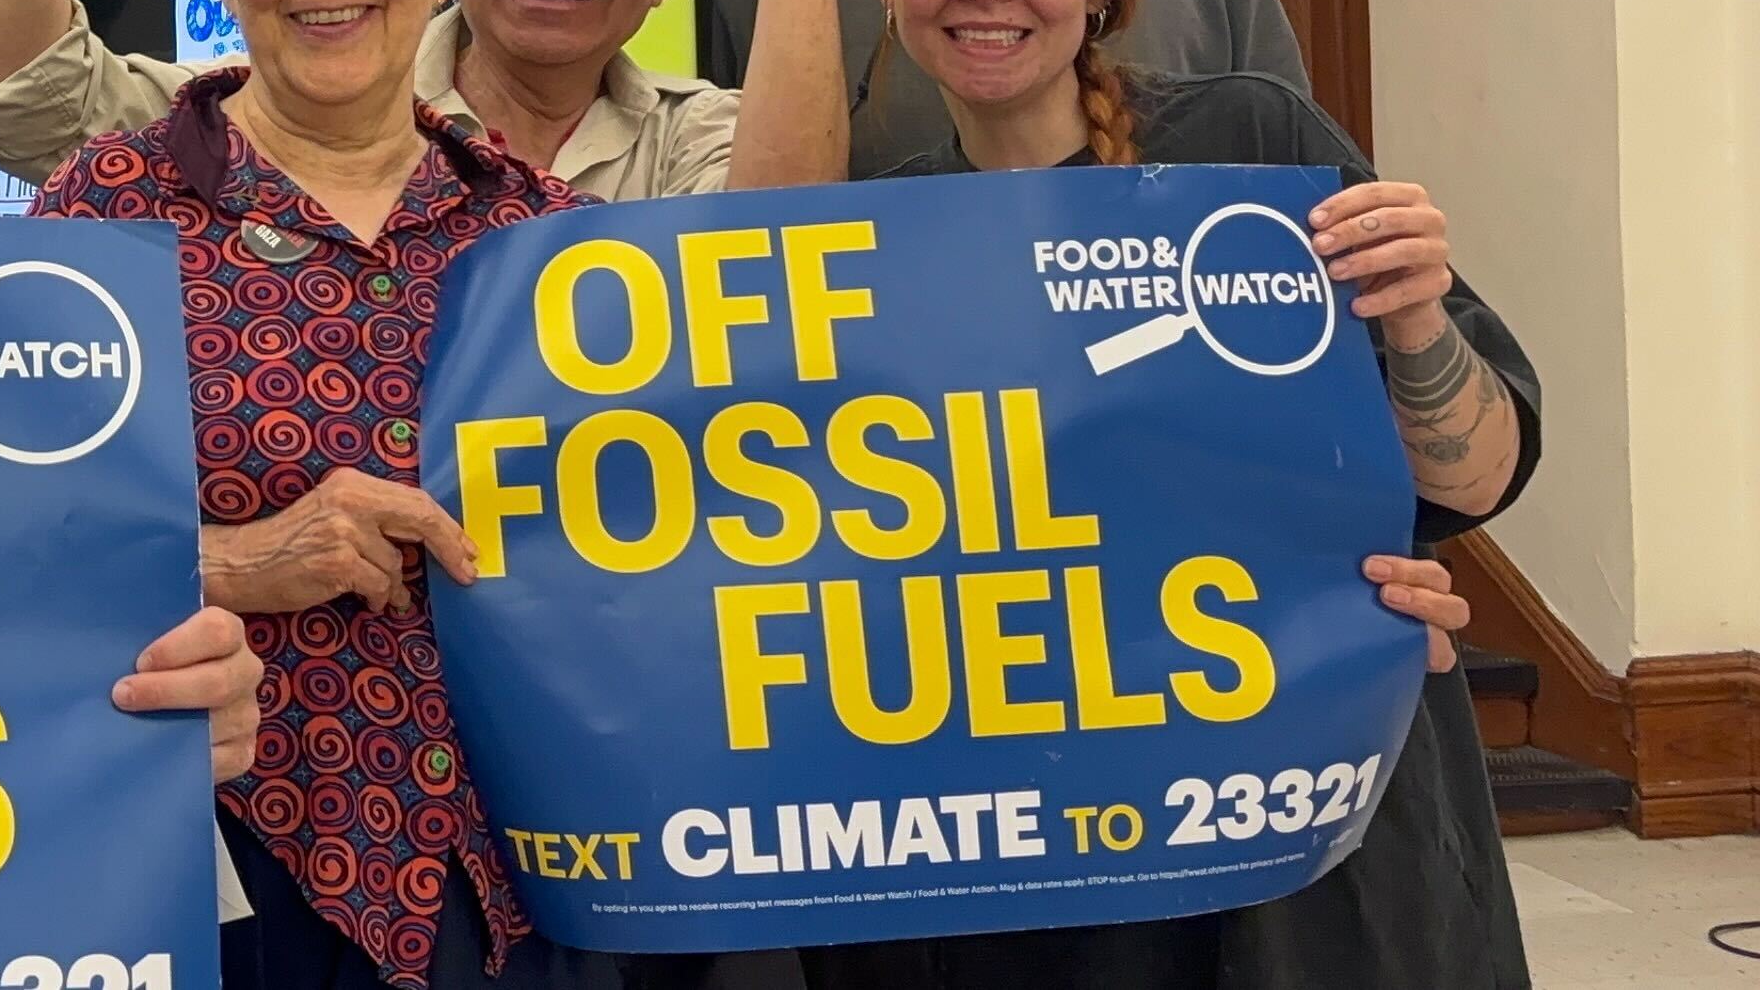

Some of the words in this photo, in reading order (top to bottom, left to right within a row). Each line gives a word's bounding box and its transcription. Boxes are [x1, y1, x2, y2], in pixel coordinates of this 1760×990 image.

[255, 224, 282, 249] GAZA
[1044, 275, 1181, 312] WATER
[1194, 271, 1322, 307] WATCH
[534, 220, 876, 397] OFF
[455, 388, 1102, 579] FOSSIL
[714, 554, 1278, 752] FUELS
[506, 827, 640, 881] TEXT
[662, 790, 1046, 877] CLIMATE
[1065, 804, 1145, 853] TO
[1165, 753, 1381, 845] 23321
